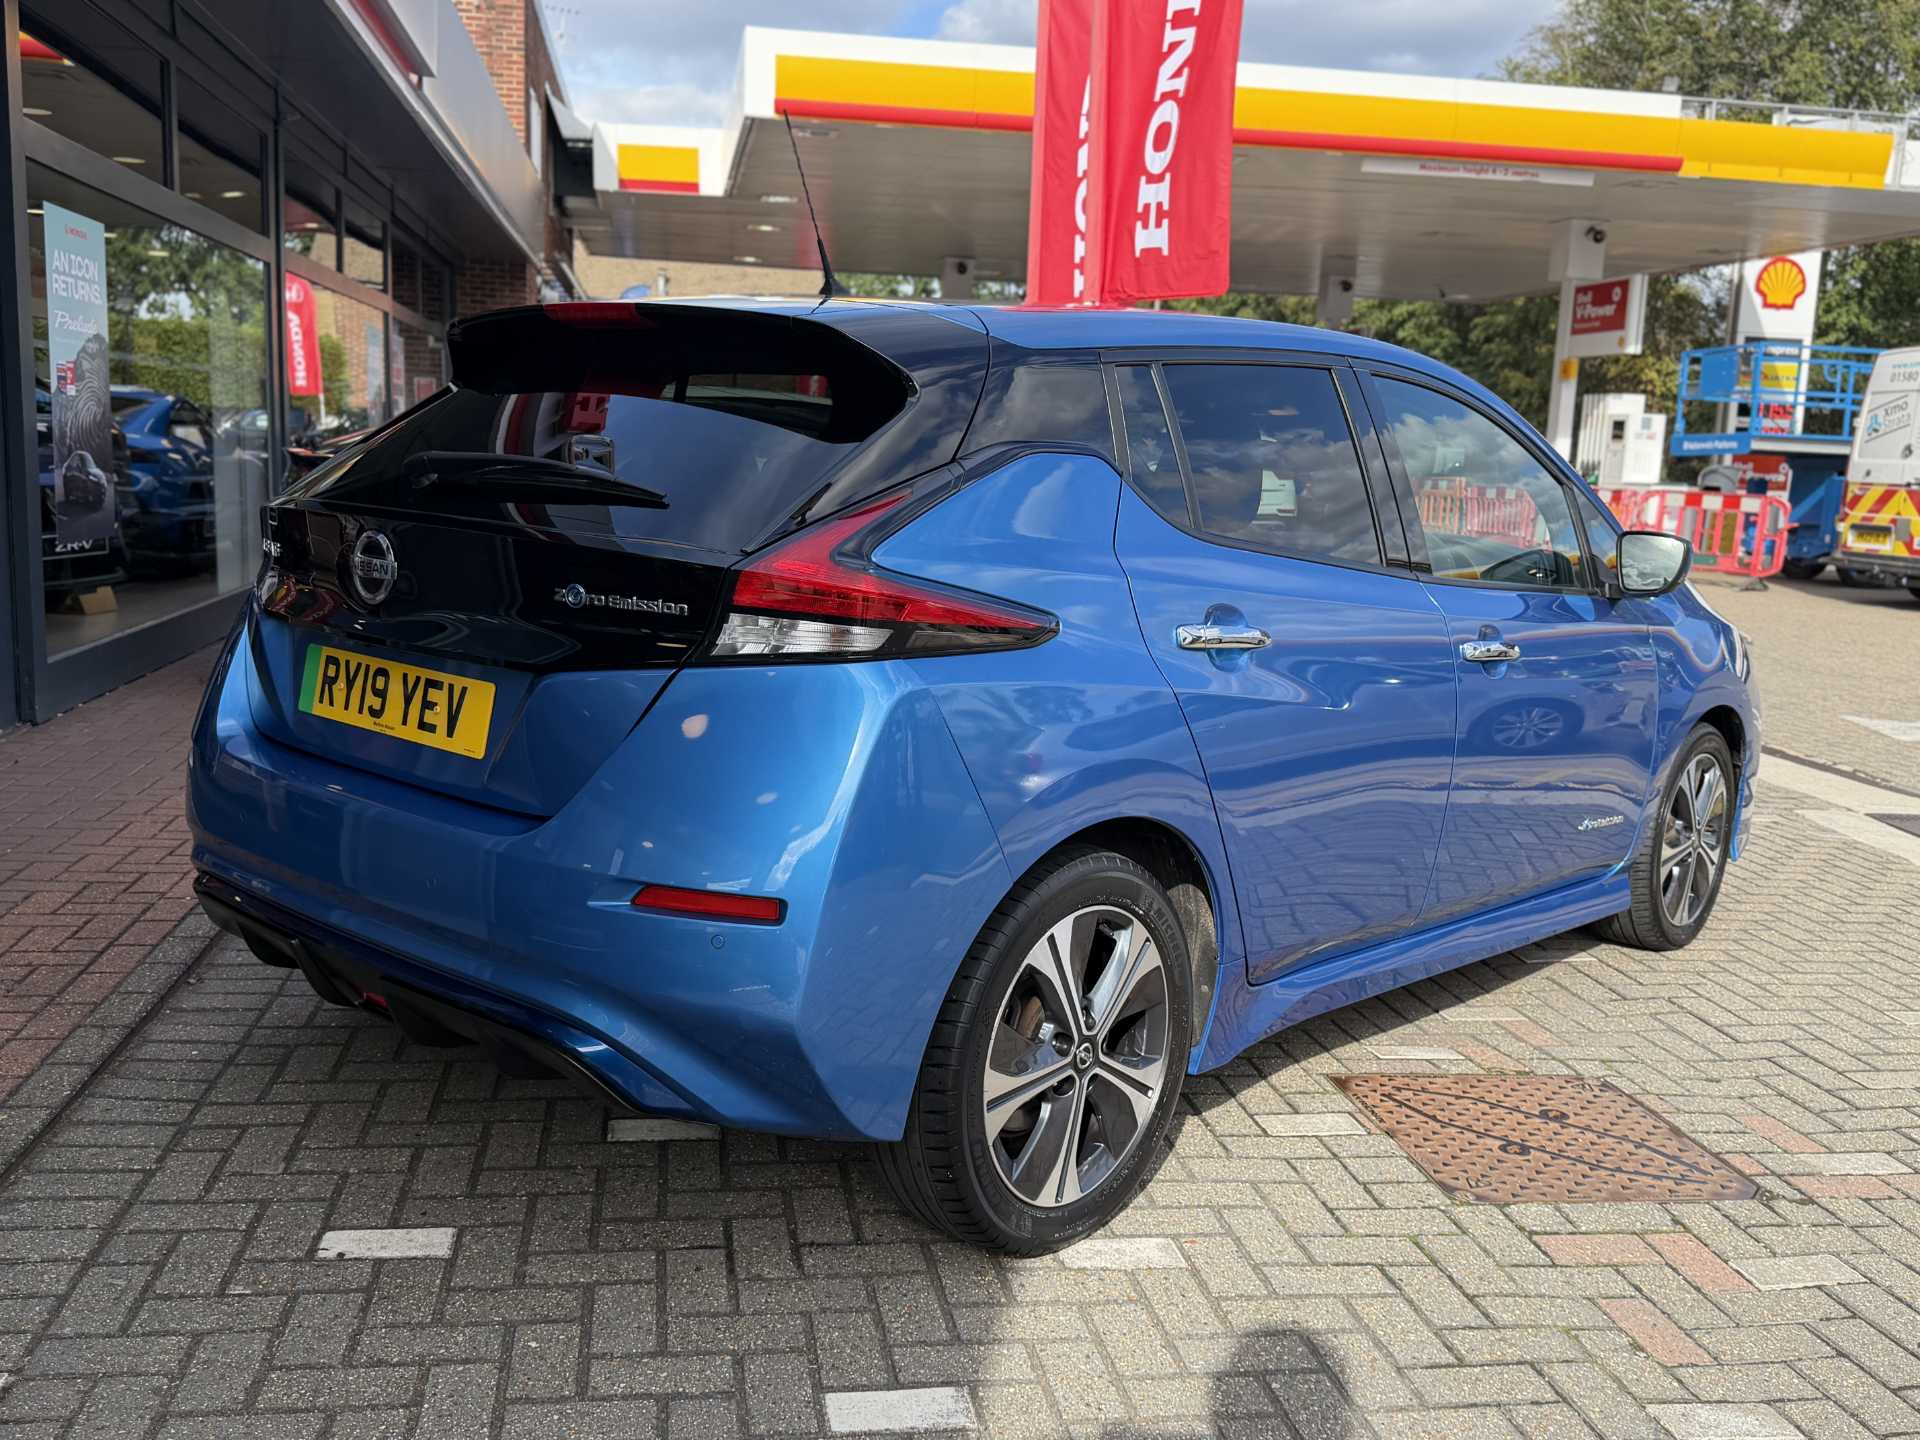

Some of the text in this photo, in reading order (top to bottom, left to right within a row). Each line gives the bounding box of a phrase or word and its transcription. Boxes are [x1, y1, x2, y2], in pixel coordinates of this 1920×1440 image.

[1134, 0, 1201, 258] HON
[52, 248, 99, 283] AN ICON
[52, 273, 102, 305] RETURNS
[608, 594, 689, 616] Emission
[318, 654, 469, 739] RY19 YEV
